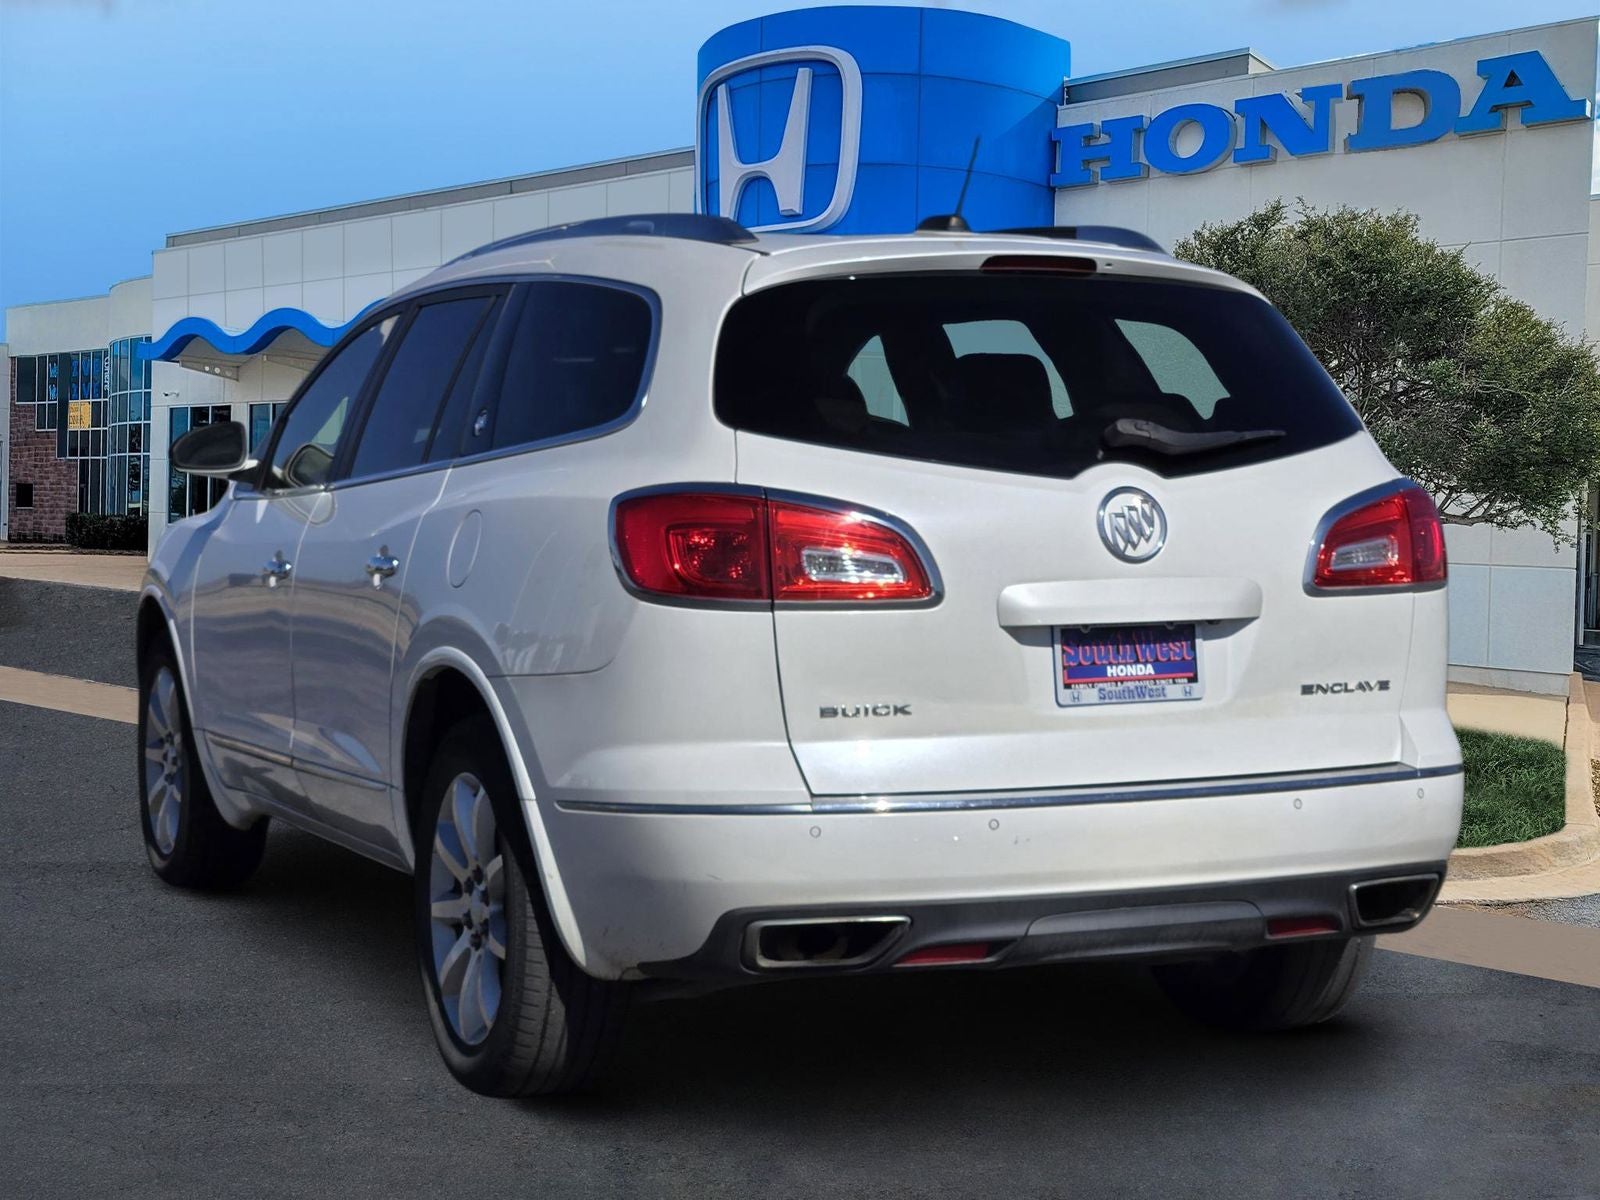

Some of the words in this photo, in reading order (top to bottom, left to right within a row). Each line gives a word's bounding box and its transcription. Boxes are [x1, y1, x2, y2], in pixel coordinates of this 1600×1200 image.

[1050, 50, 1591, 188] HONDA
[1106, 664, 1155, 677] HONDA
[1098, 685, 1167, 700] SouthWest
[1300, 679, 1391, 696] ENCLAVE
[819, 703, 912, 719] BUICK
